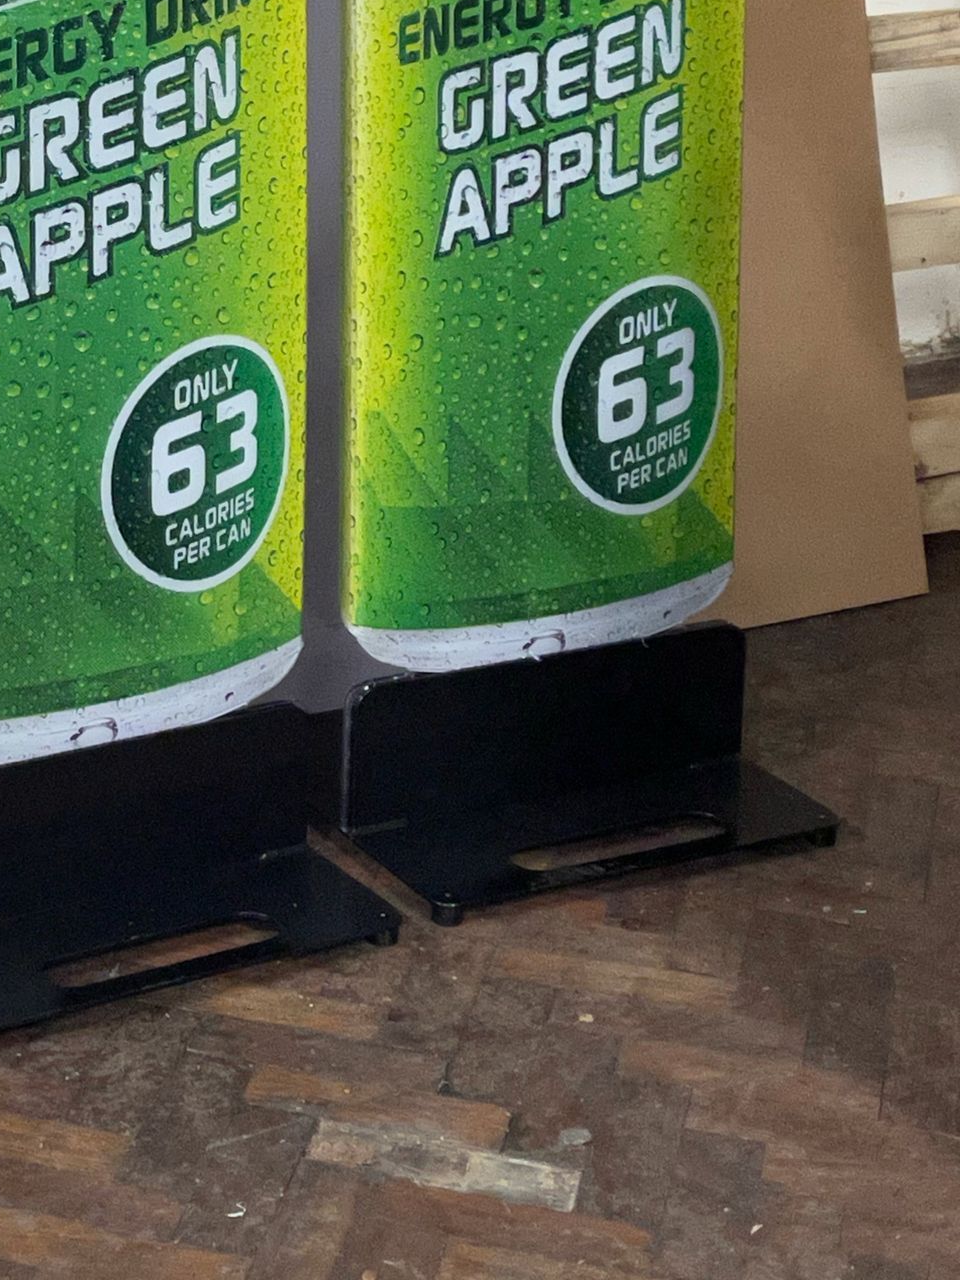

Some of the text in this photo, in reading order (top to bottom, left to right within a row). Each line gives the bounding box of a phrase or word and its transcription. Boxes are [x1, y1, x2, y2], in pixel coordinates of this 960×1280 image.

[434, 85, 683, 260] APPLE
[618, 298, 677, 345] ONLY
[174, 358, 239, 410] ONLY
[597, 327, 695, 443] 63
[151, 389, 258, 516] 63
[610, 420, 691, 471] CALORIES
[617, 447, 688, 494] PER CAN
[165, 487, 255, 546] CALORIES
[173, 517, 251, 570] PER CAN
